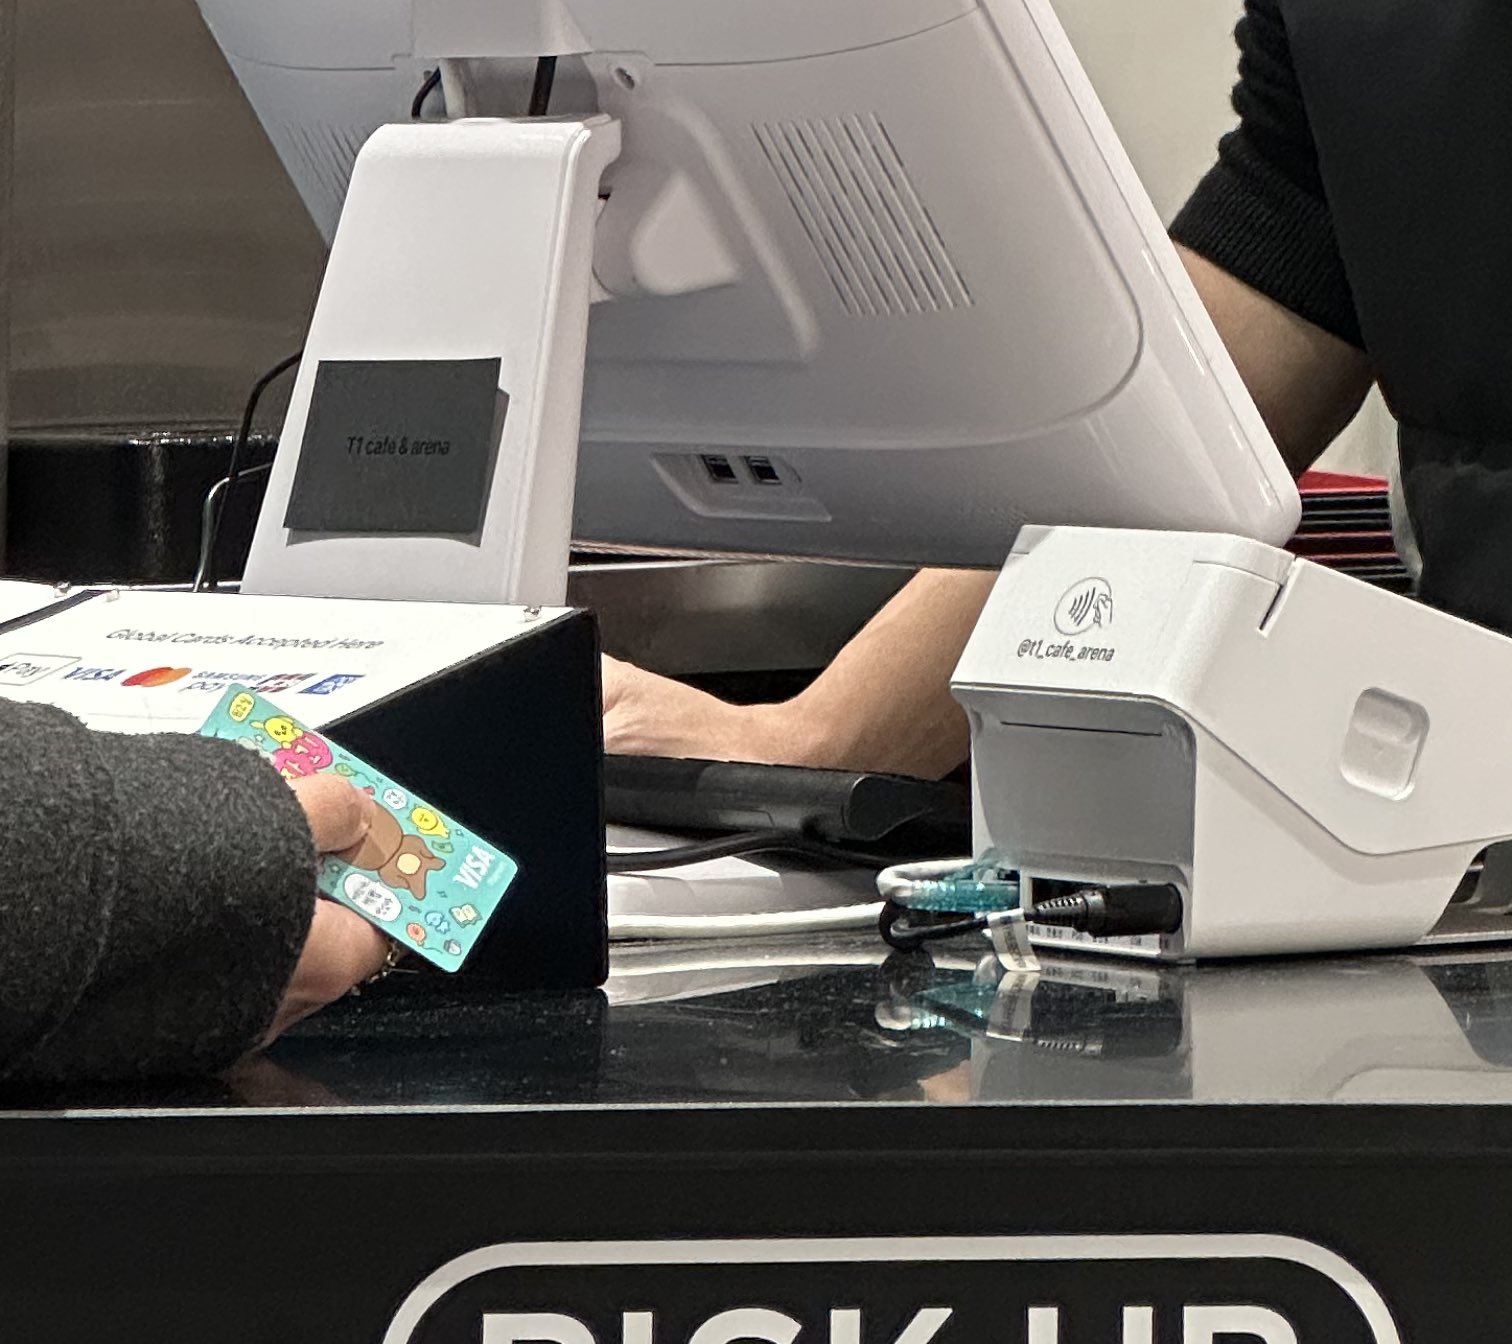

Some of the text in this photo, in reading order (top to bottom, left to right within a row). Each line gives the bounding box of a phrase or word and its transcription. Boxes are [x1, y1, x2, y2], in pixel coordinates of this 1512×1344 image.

[366, 436, 397, 455] cafe
[398, 436, 409, 455] &
[410, 439, 450, 456] arena
[1016, 638, 1115, 662] @t1_cafe_arena
[453, 844, 497, 890] VISA
